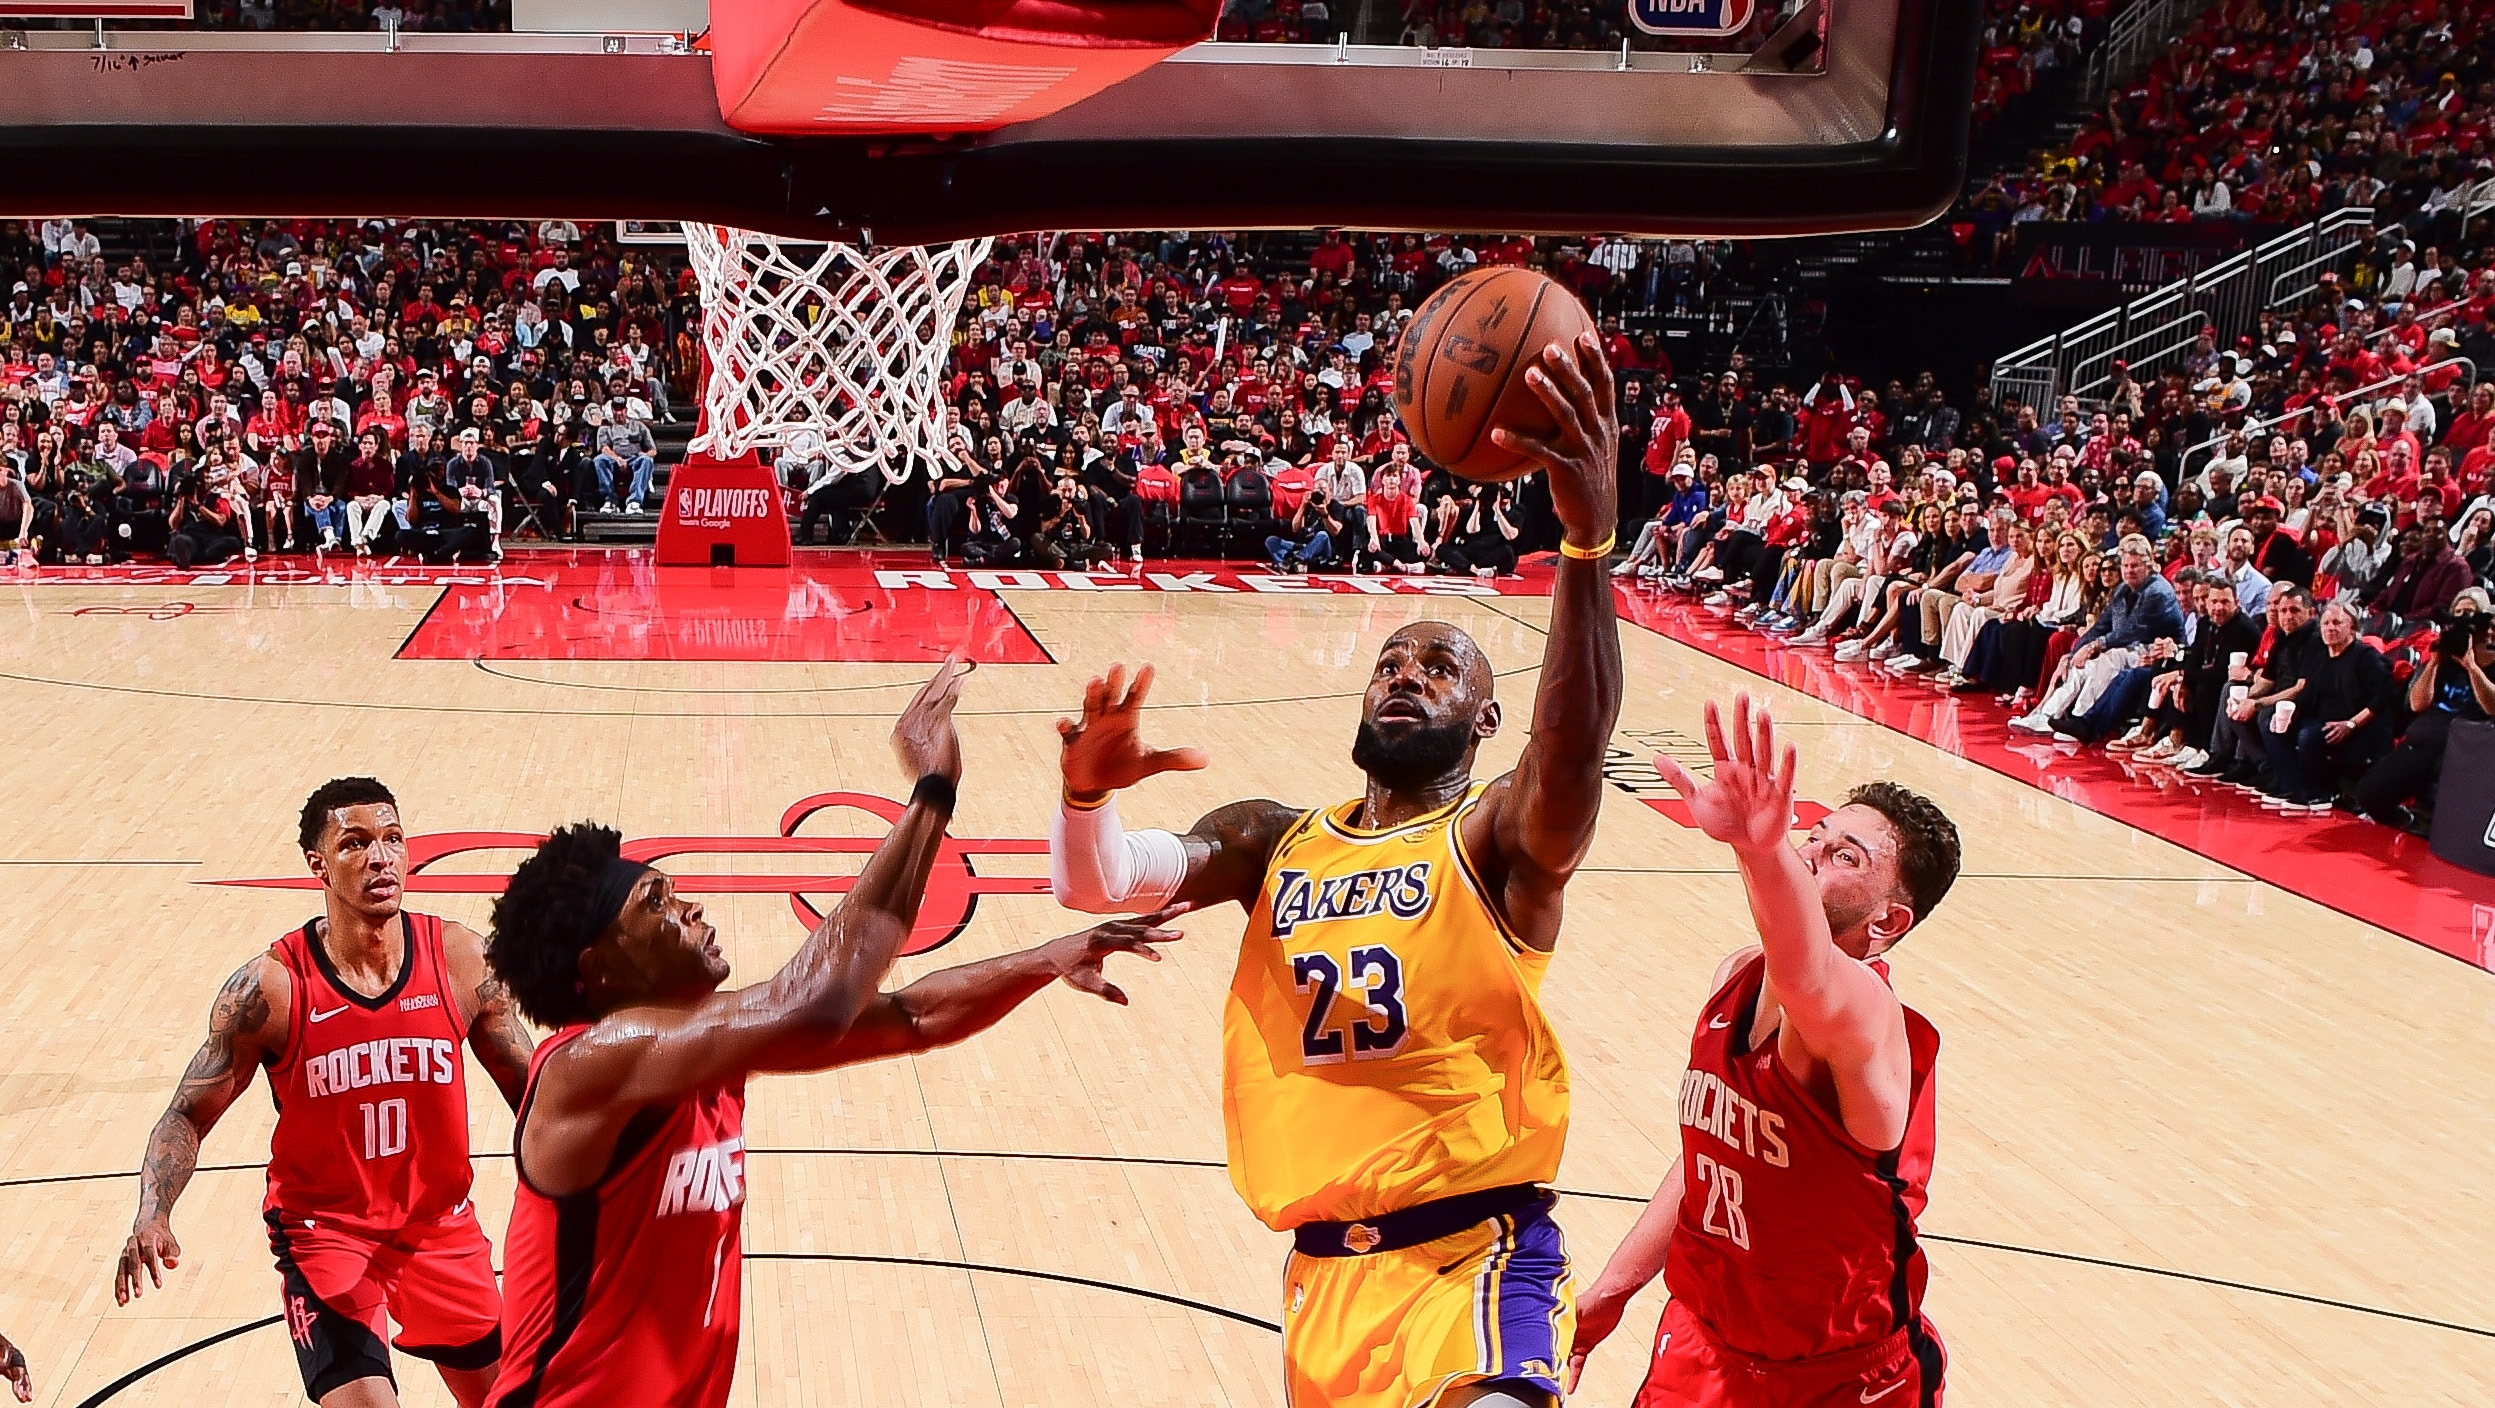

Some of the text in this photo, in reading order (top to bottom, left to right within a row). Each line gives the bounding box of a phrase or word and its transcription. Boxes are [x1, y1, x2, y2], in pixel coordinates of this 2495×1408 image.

[693, 488, 770, 518] PLAYOFFS
[700, 518, 731, 530] Google
[873, 571, 1502, 597] ROCKETS
[1270, 860, 1432, 940] LAKERS
[1290, 943, 1411, 1067] 23
[305, 1037, 454, 1098] ROCKETS
[359, 1098, 407, 1160] 10
[1696, 1152, 1751, 1251] 28
